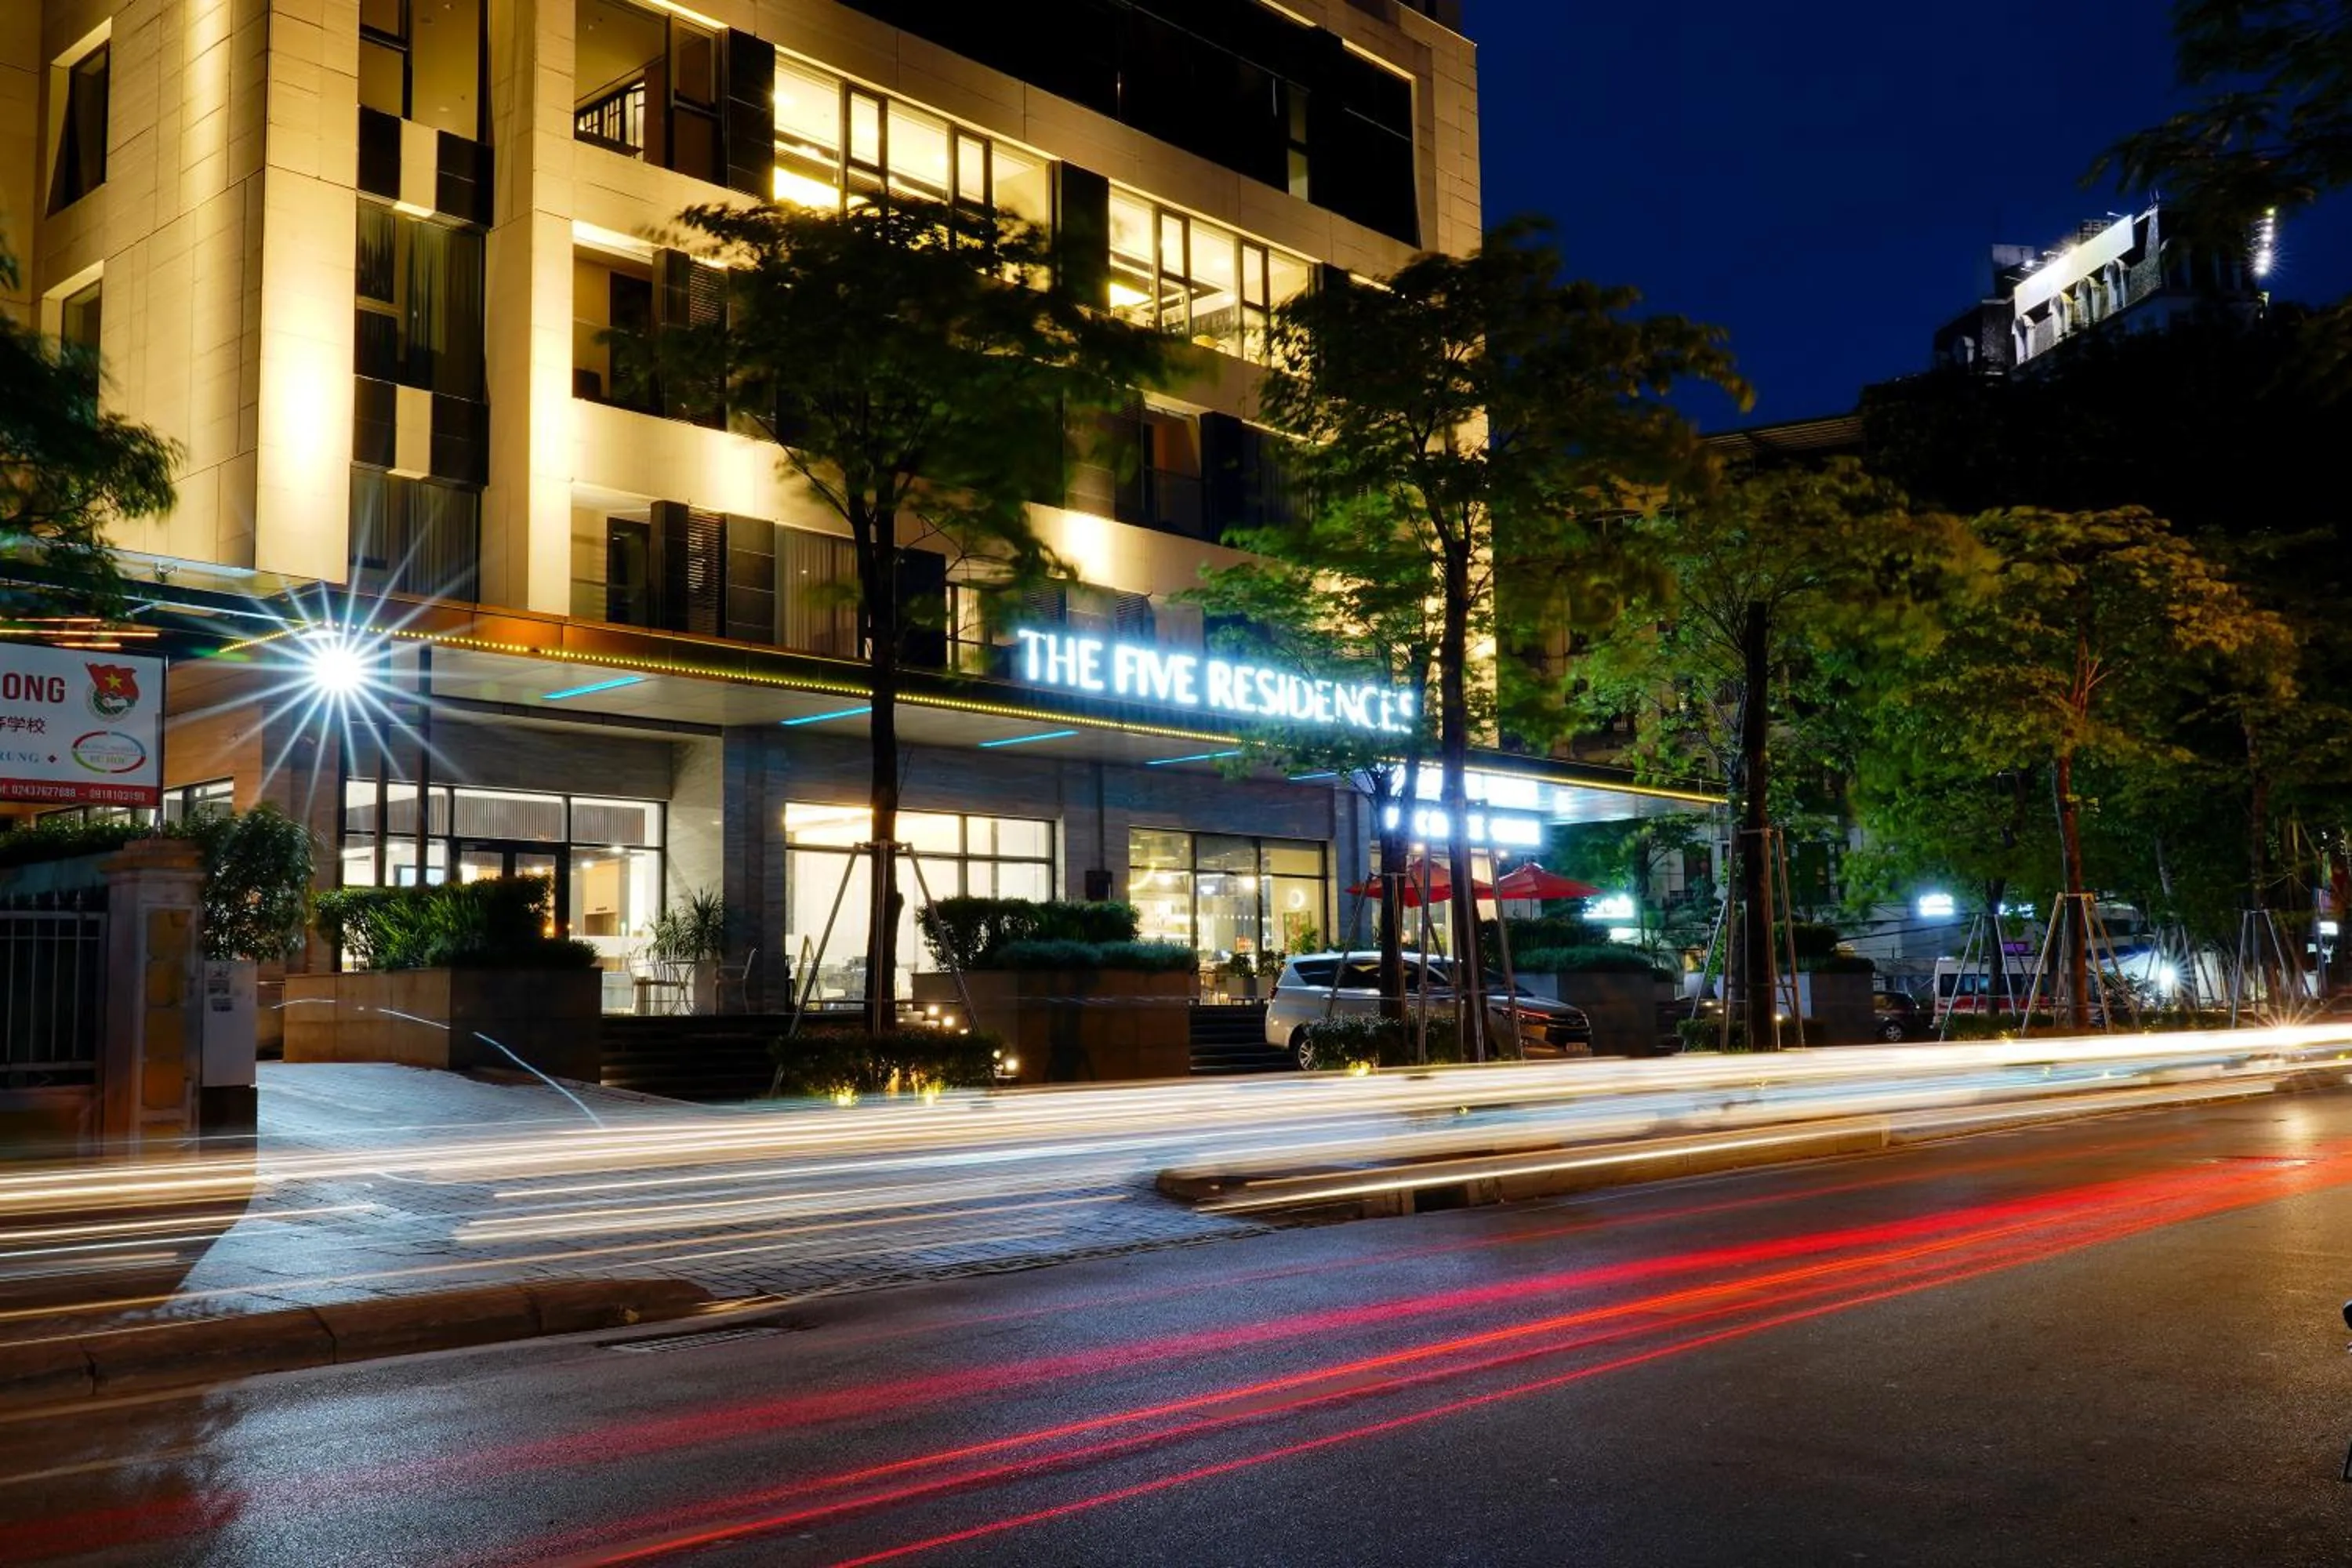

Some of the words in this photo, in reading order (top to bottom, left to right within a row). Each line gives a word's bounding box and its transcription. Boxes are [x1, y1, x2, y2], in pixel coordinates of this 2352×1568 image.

[3, 673, 64, 703] ONG
[1018, 630, 1103, 690] THE
[1115, 644, 1197, 704] FIVE
[1208, 661, 1413, 734] RESIDENCES
